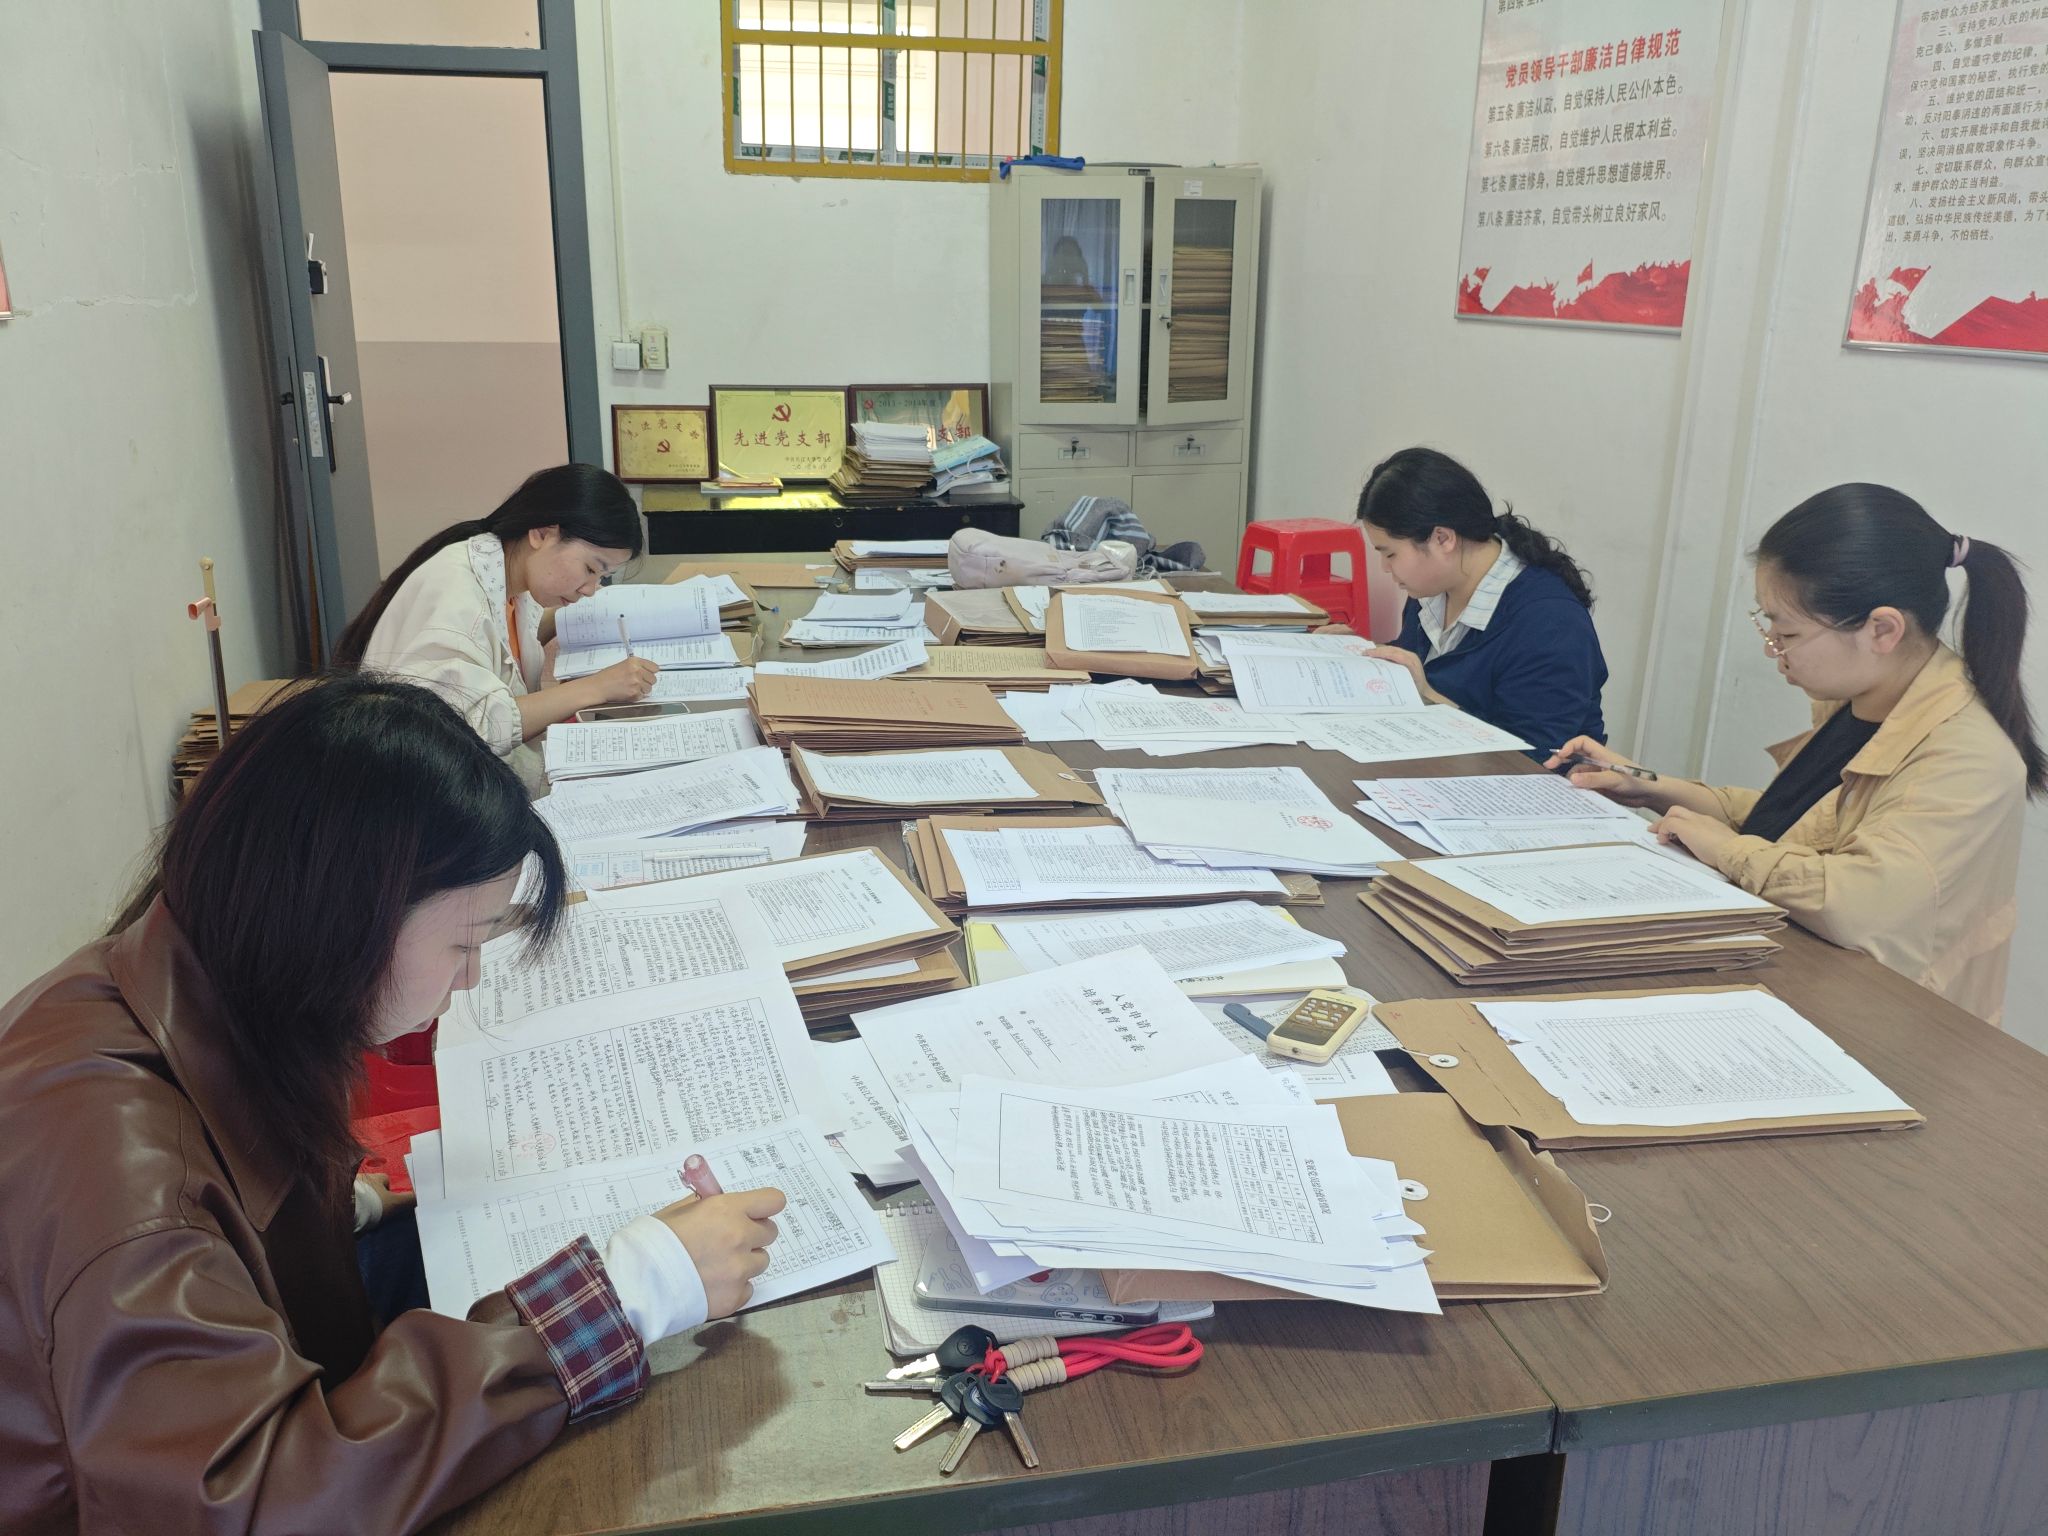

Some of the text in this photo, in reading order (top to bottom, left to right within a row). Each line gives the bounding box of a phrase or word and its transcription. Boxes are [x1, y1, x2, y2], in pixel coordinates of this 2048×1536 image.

[1505, 27, 1682, 89] 党员领导干部廉洁自律规范
[1487, 73, 1684, 124] 第五条 廉洁从政，自觉保持人民公仆本色。
[1483, 116, 1678, 160] 第六条 廉洁用权，自觉维护人民根本利益。
[1480, 159, 1672, 194] 第七条 廉洁修身，自觉提升思想道德境界。
[1915, 154, 2048, 176] 七、密切联系群众，向群众宣
[1476, 201, 1667, 229] 第八条 廉洁齐家，自觉带头树立良好家风。
[1887, 209, 2048, 227] 道德，弘扬中华民族传统美德，为了
[733, 428, 832, 449] 先进党支部
[1082, 986, 1145, 1053] 培养教育考察表
[1112, 992, 1159, 1039] 入党申请人
